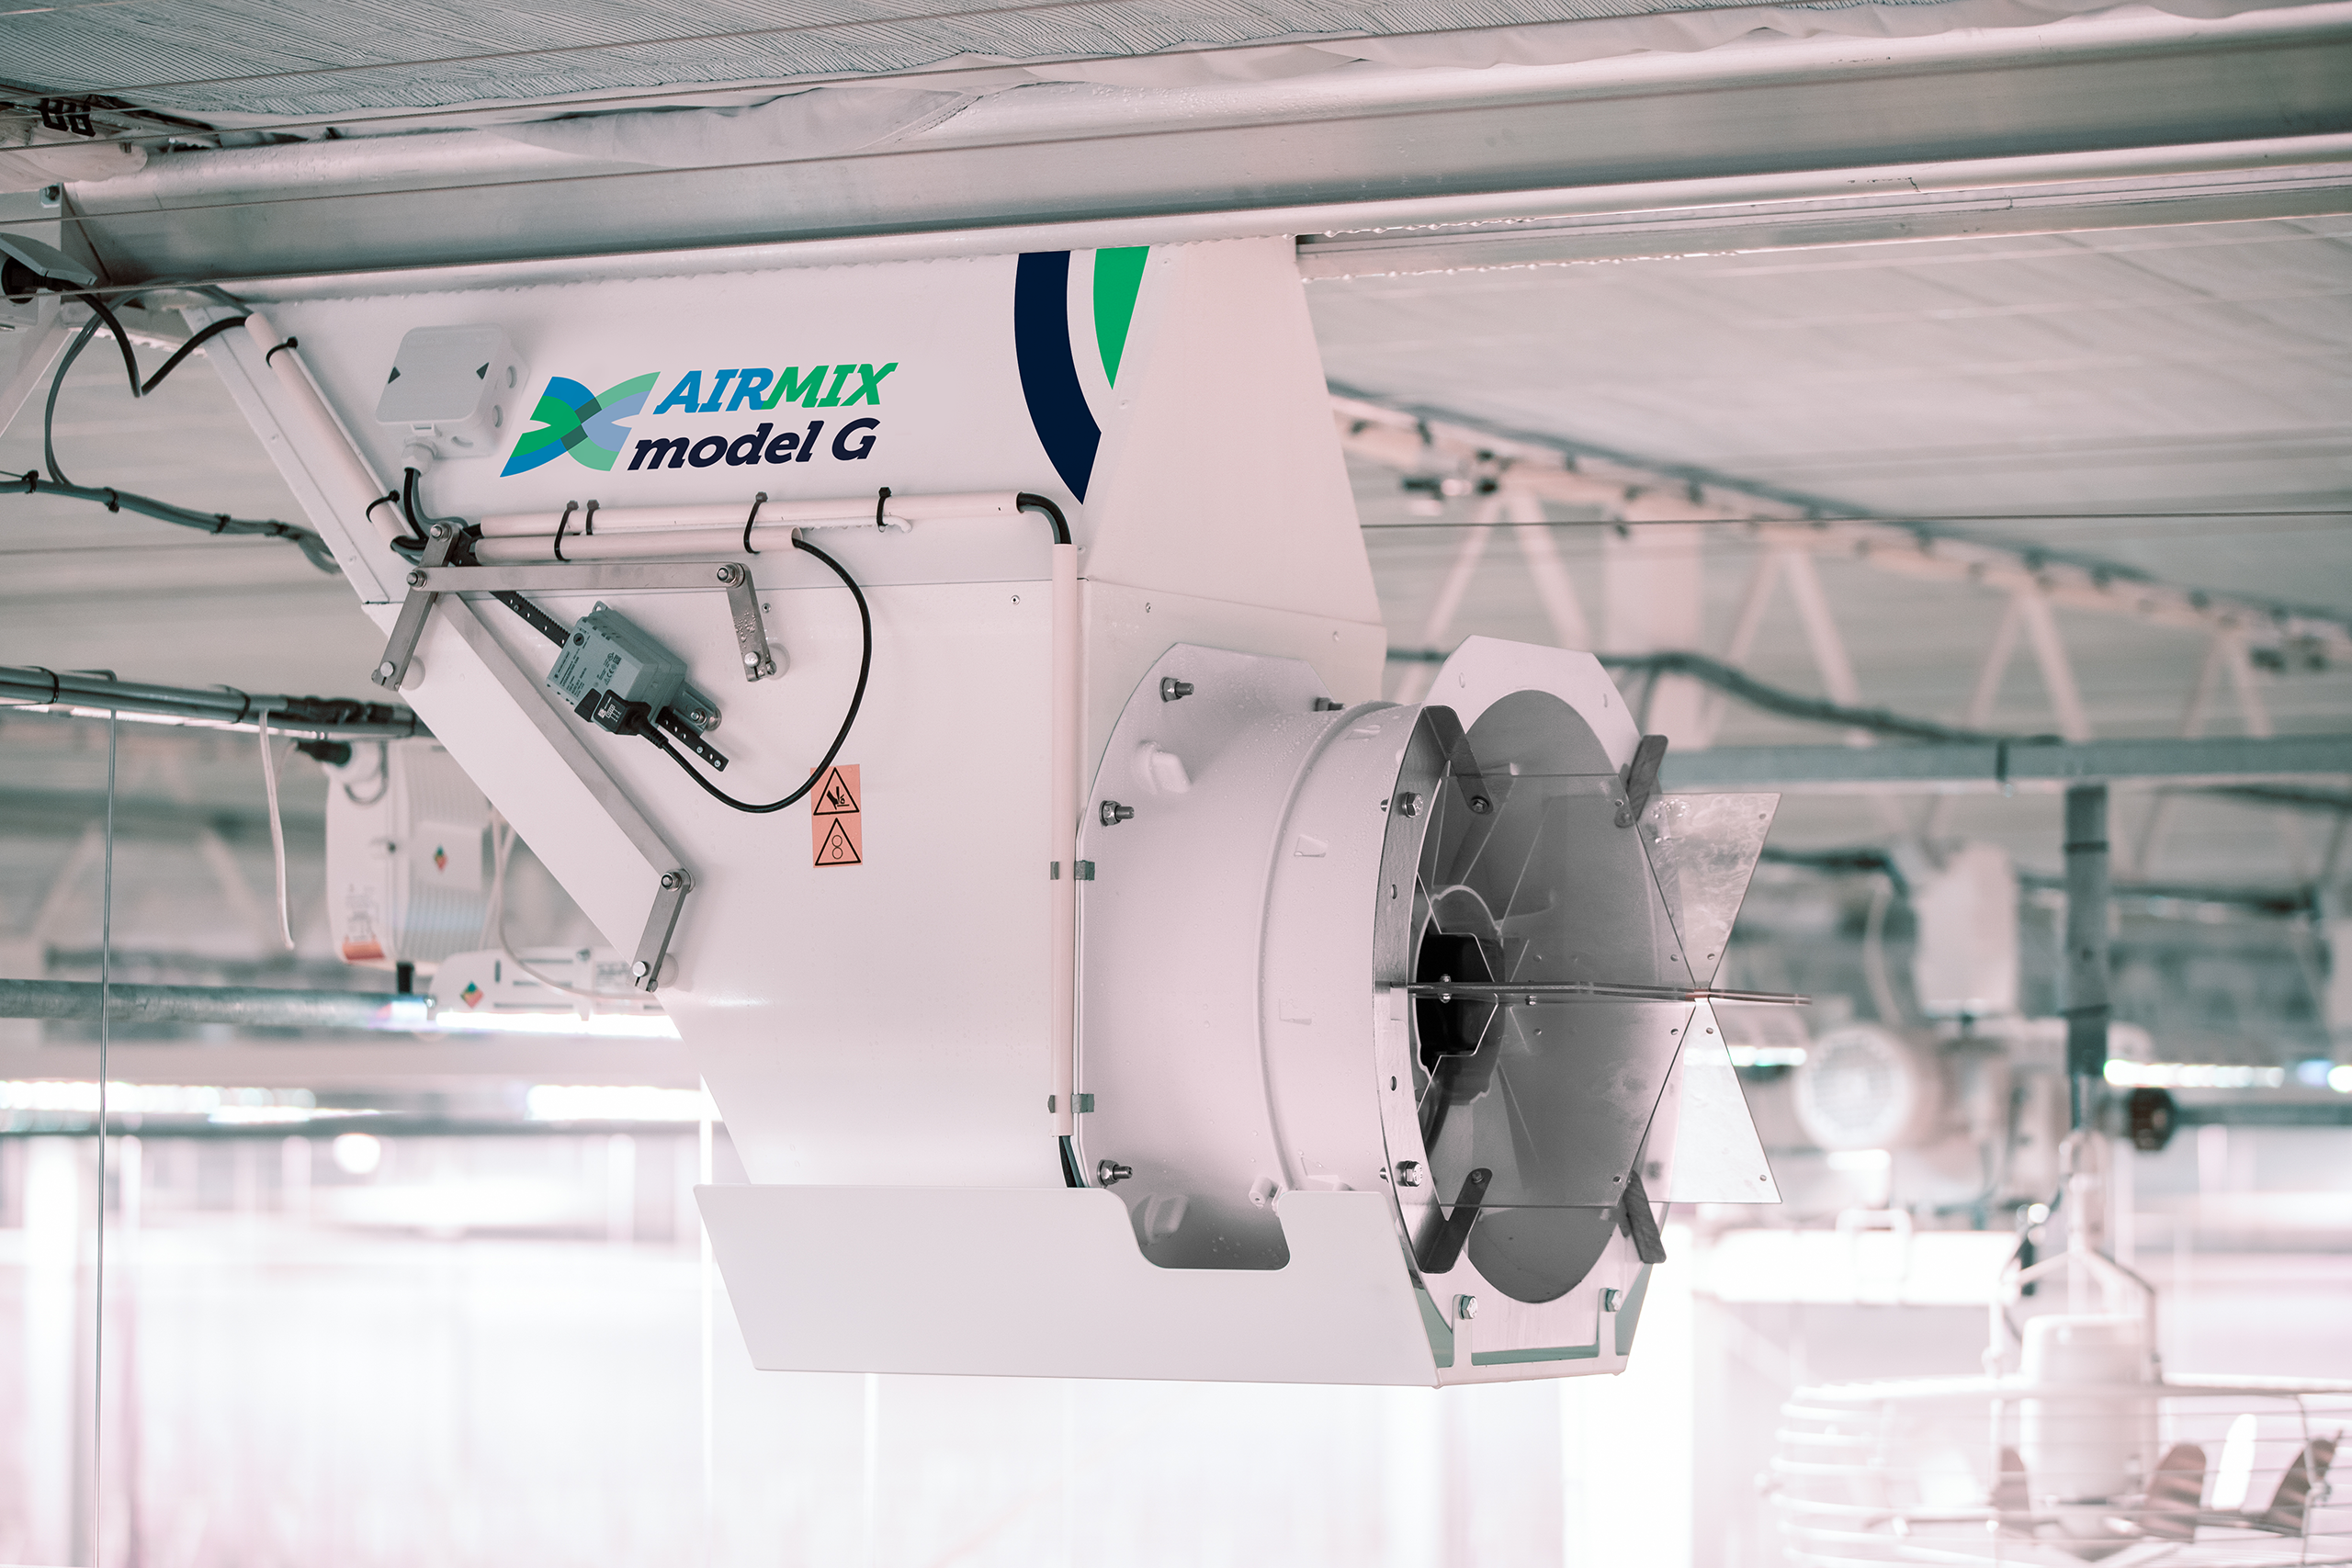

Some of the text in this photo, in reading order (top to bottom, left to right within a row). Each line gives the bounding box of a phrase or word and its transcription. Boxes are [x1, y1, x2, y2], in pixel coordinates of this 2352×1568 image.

[652, 362, 899, 415] AIRMIX
[627, 417, 881, 470] model G
